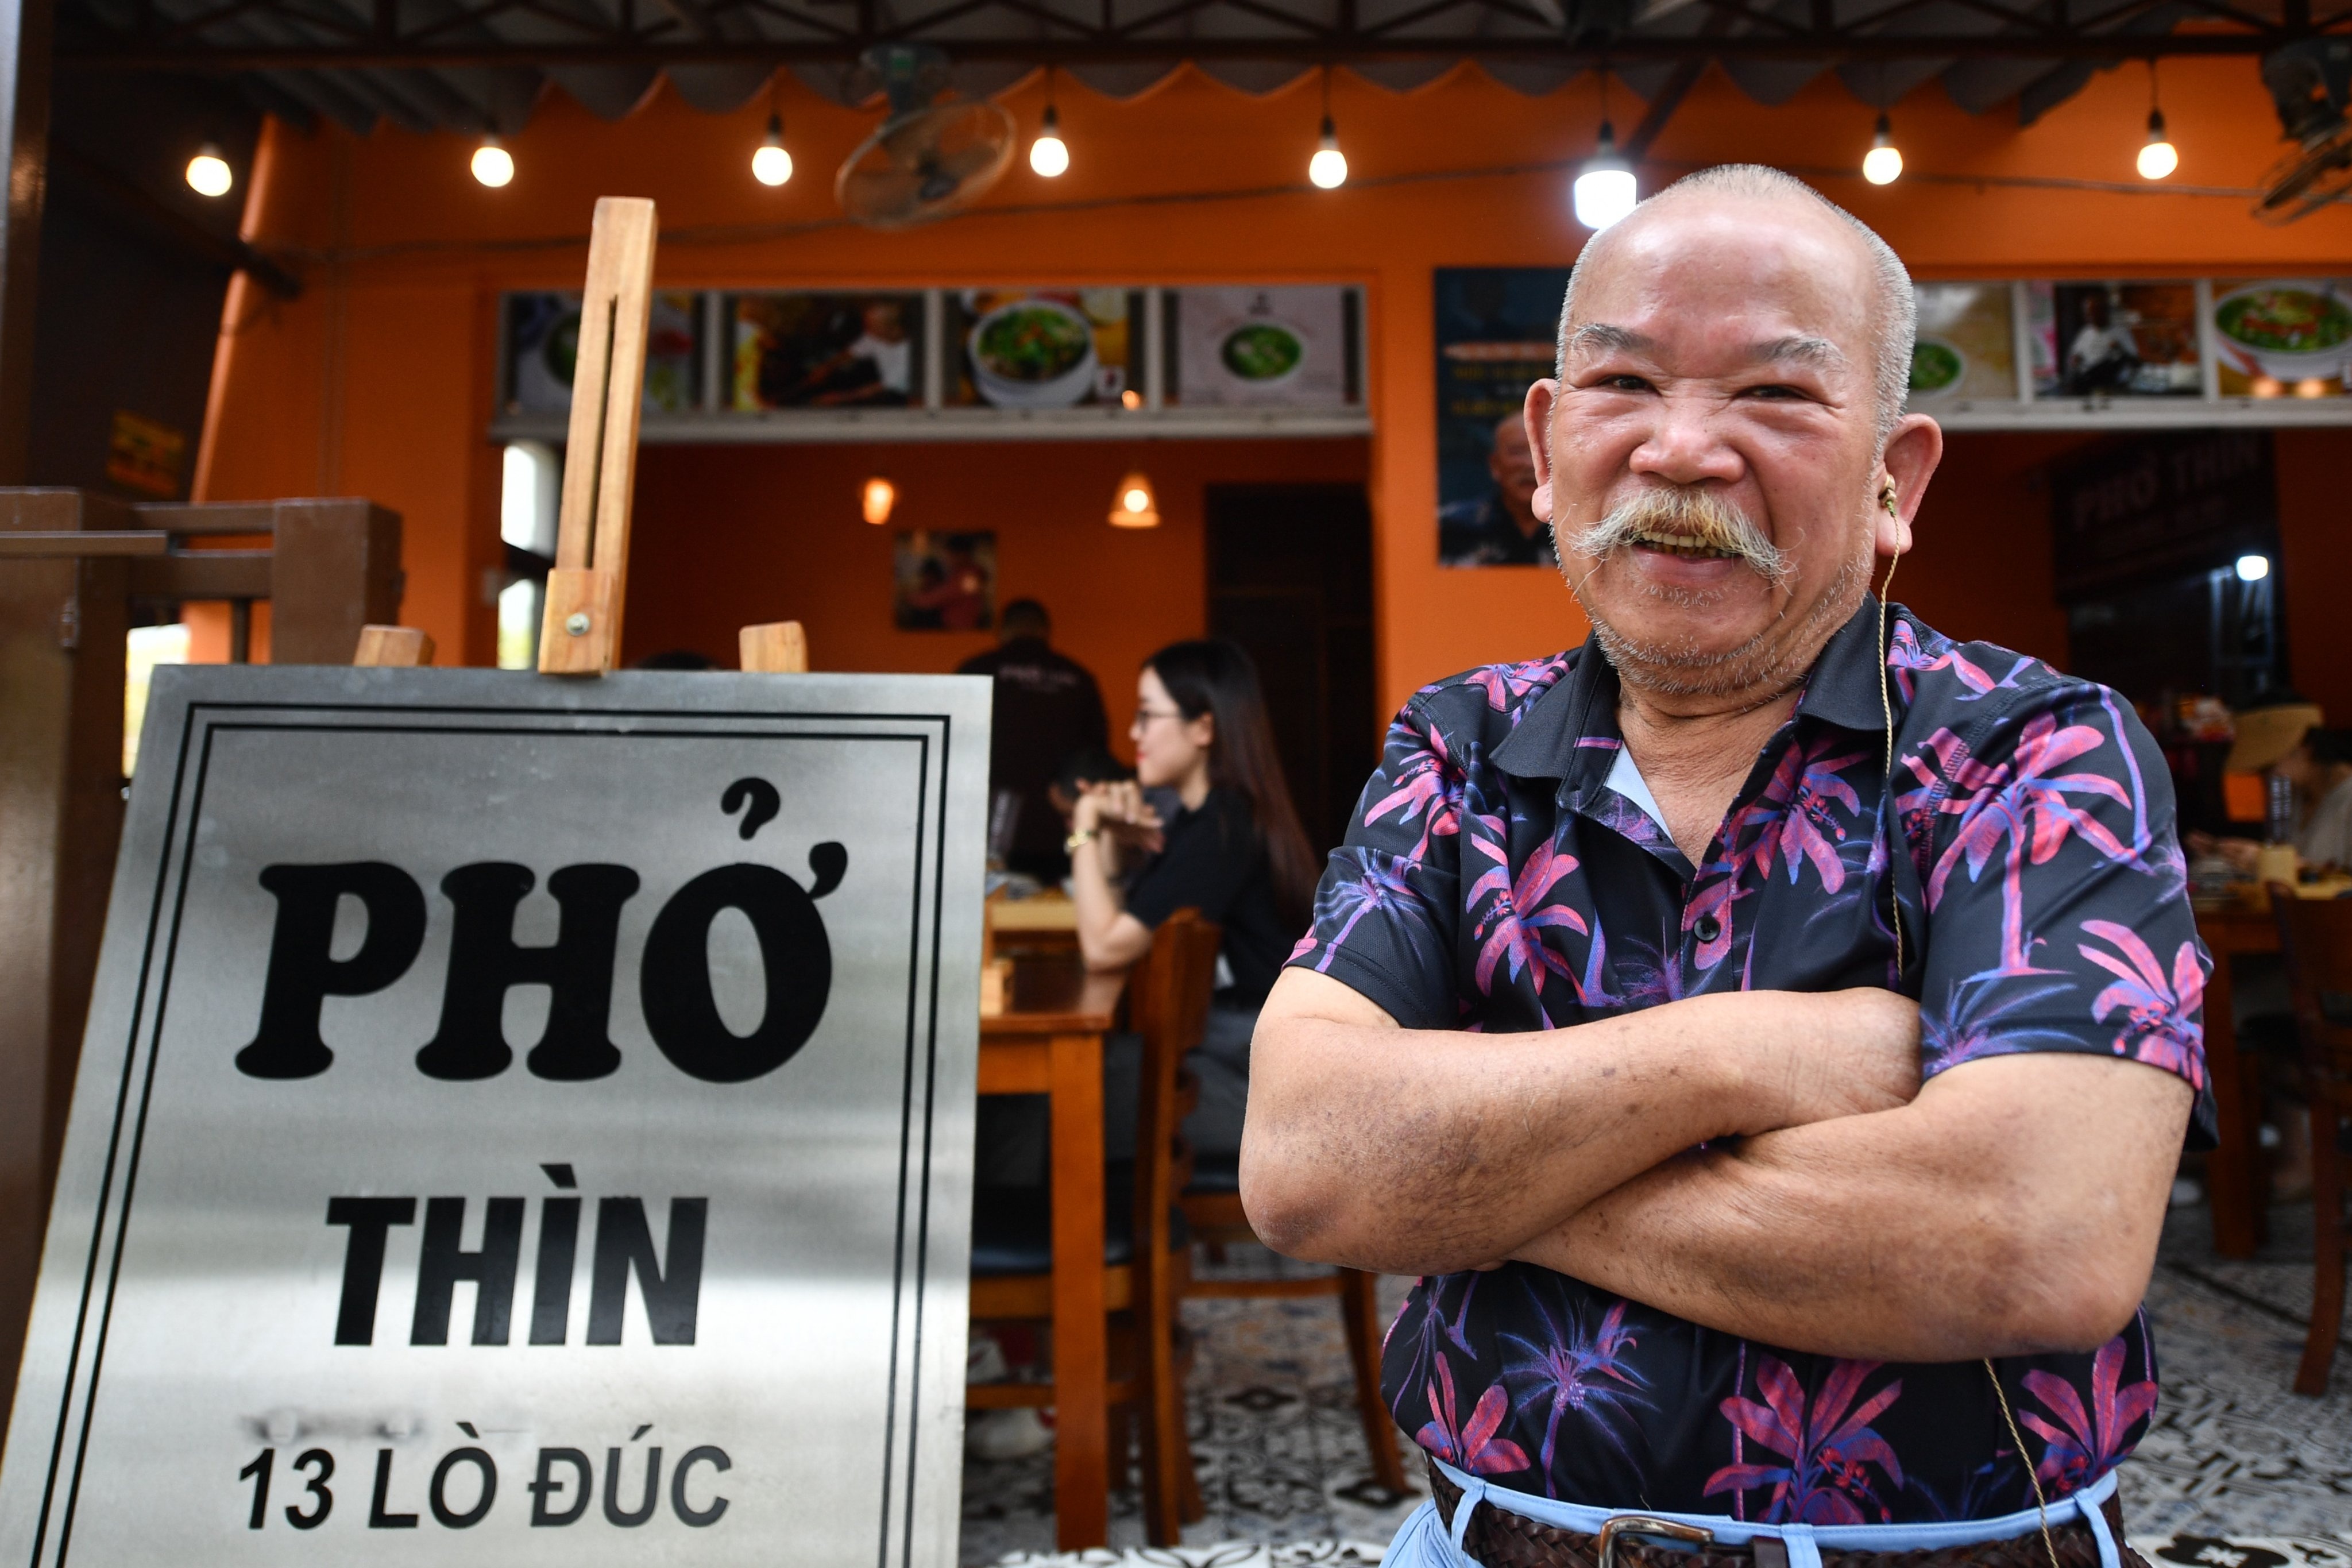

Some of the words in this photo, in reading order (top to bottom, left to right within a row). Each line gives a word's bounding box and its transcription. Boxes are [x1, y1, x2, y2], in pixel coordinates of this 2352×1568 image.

[234, 776, 848, 1084] PHỞ
[325, 1162, 710, 1346] THÌN
[238, 1447, 336, 1531] 13
[368, 1422, 498, 1530] LÒ
[527, 1423, 732, 1528] ĐÚC
